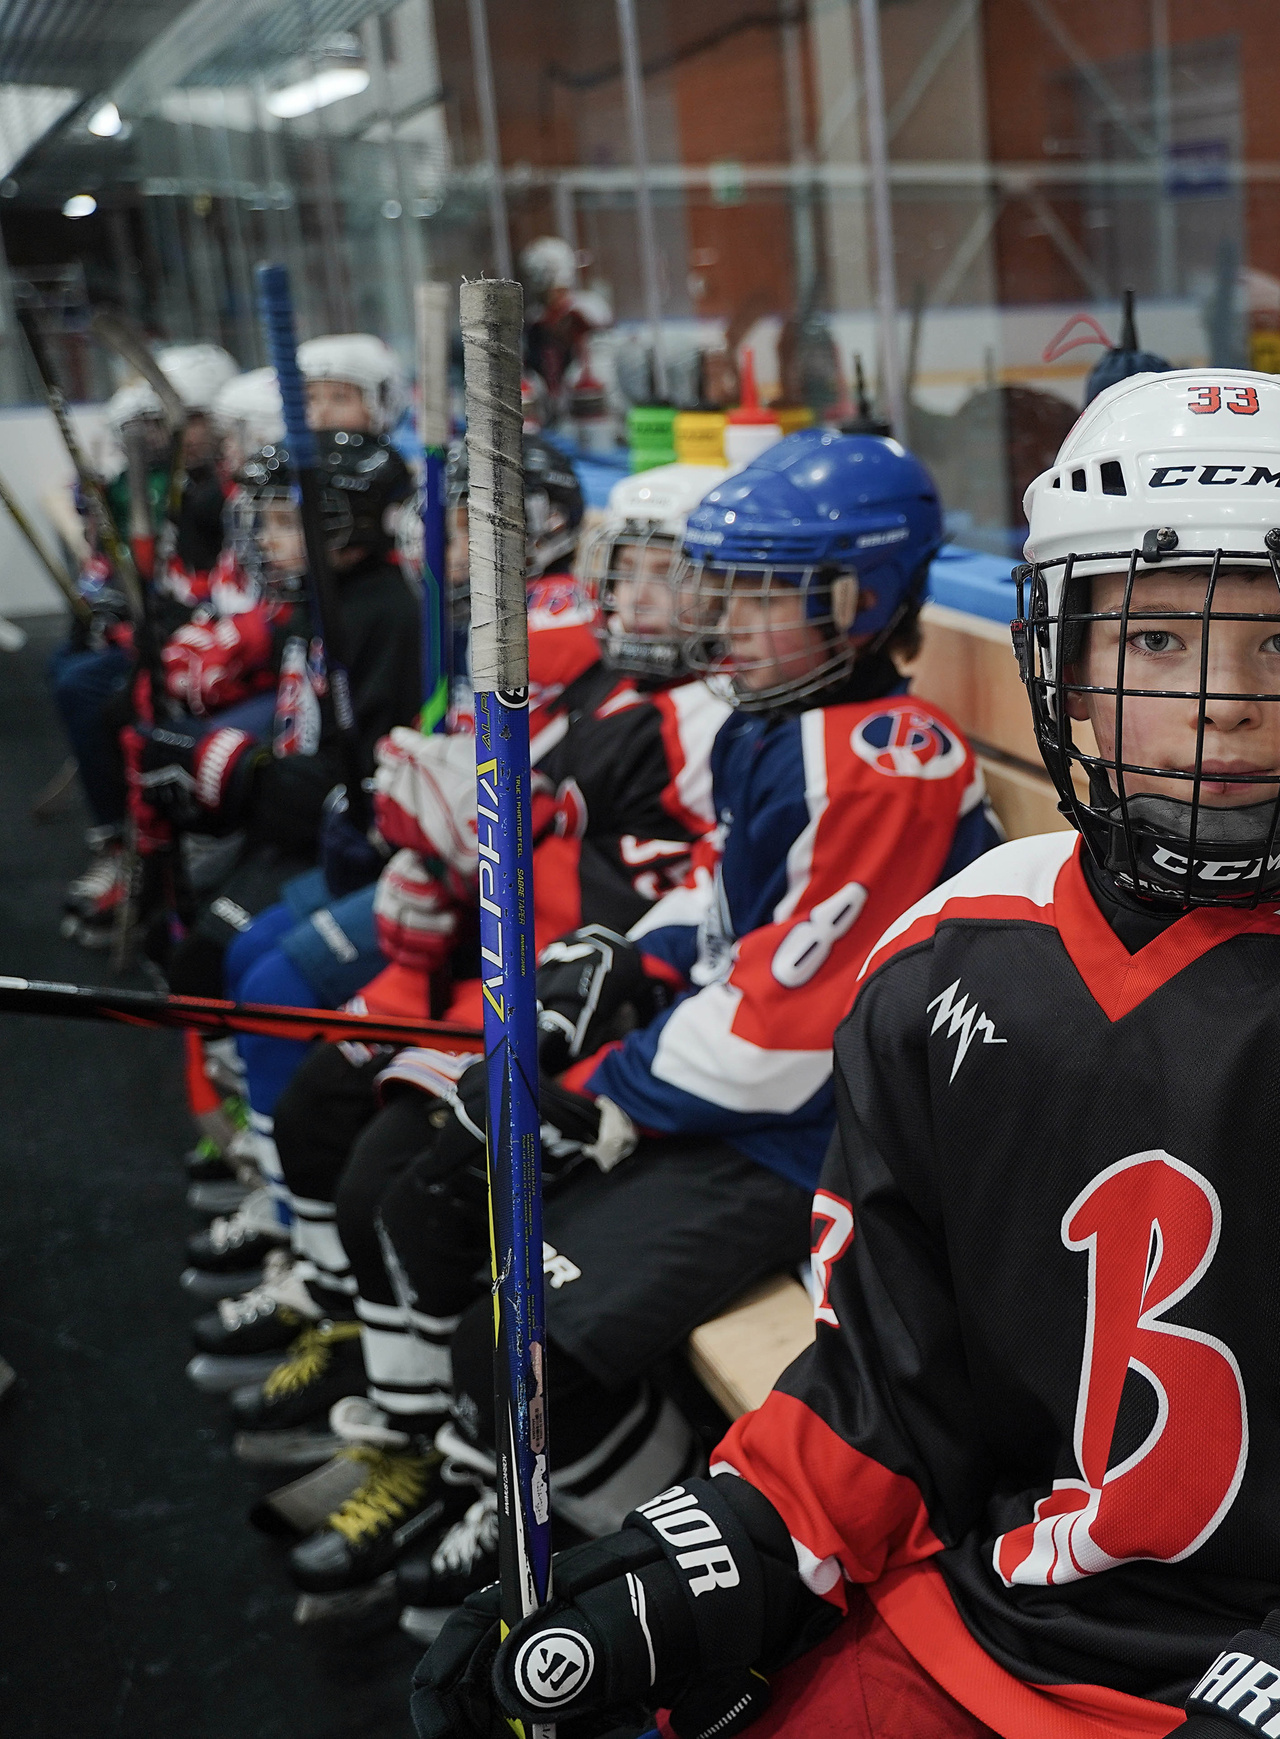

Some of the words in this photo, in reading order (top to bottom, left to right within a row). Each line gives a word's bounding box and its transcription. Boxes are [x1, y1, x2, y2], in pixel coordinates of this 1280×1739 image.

[1187, 386, 1260, 416] 33
[480, 692, 492, 752] ALP
[476, 757, 505, 1024] ALPHA
[517, 868, 525, 898] SABRE
[771, 881, 869, 988] 8
